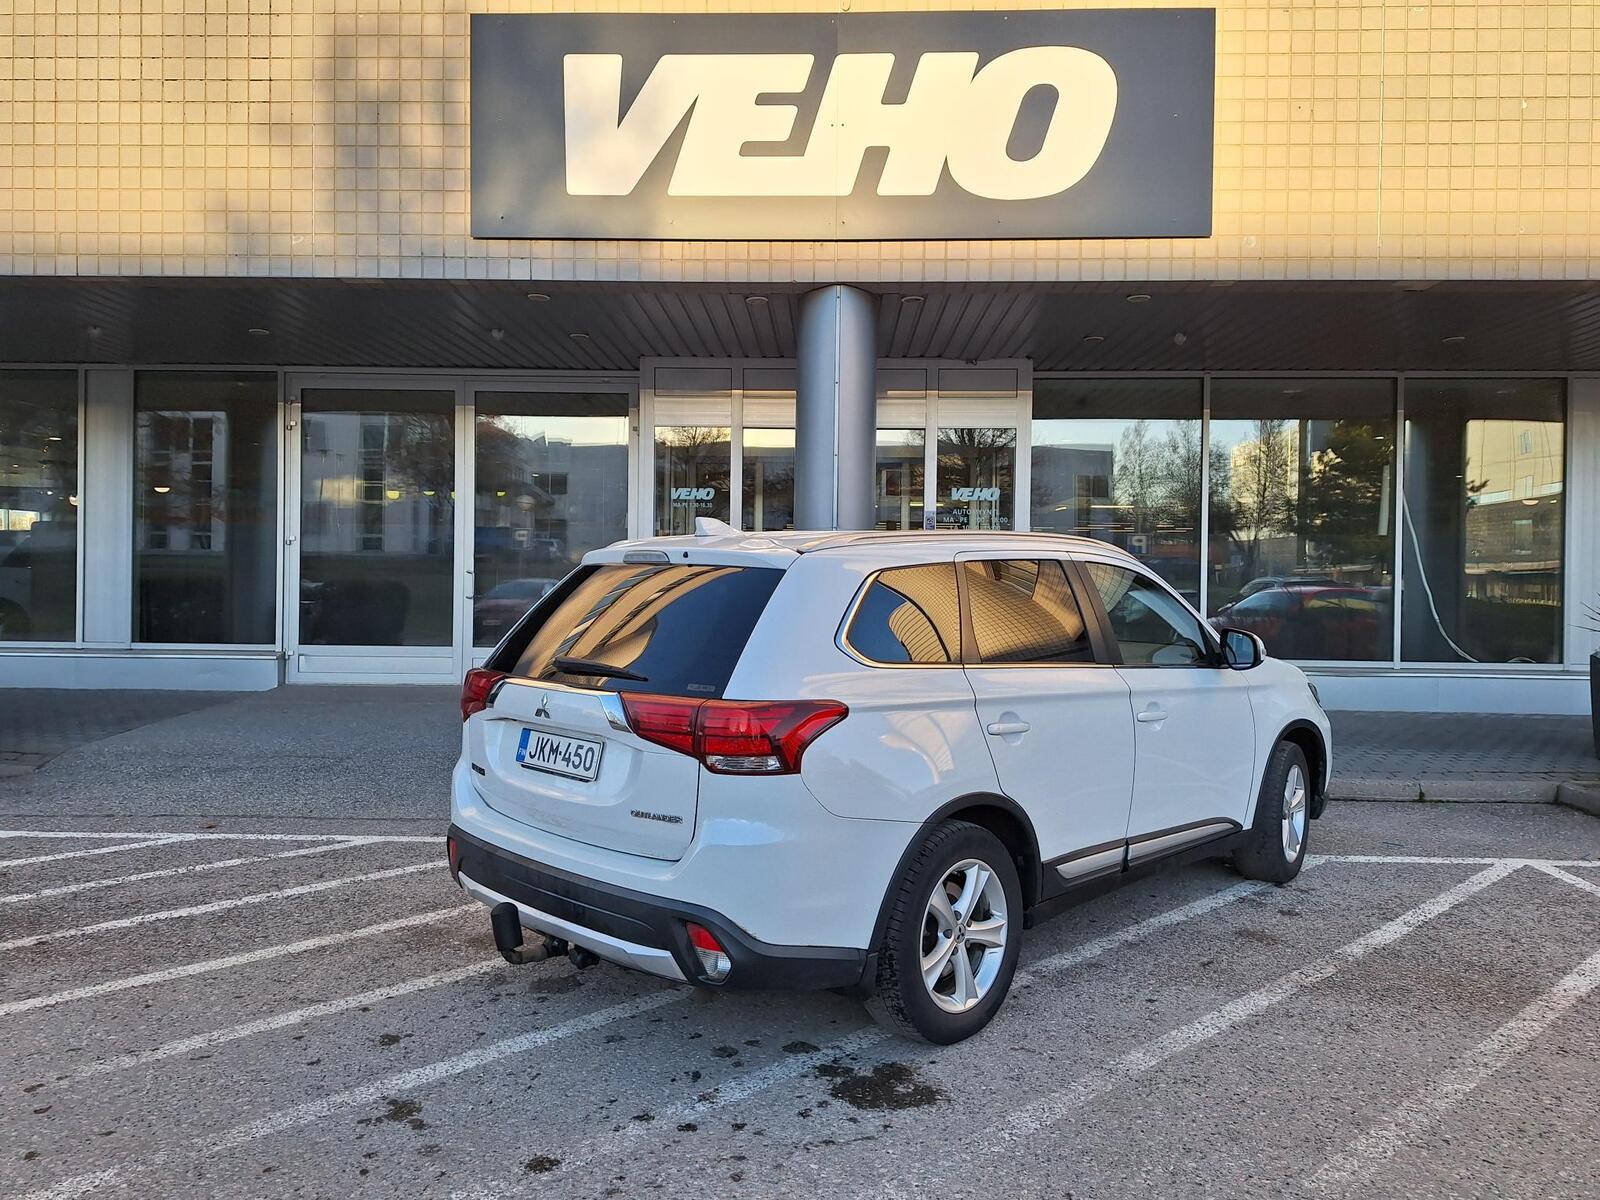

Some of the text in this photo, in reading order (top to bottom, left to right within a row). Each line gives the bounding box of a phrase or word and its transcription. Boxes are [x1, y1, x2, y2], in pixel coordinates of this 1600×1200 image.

[563, 45, 1119, 200] VEHO
[671, 487, 715, 500] VEHO
[951, 487, 1000, 500] VEHO
[529, 736, 595, 772] JKM-450
[631, 809, 683, 824] OUTLANDER
